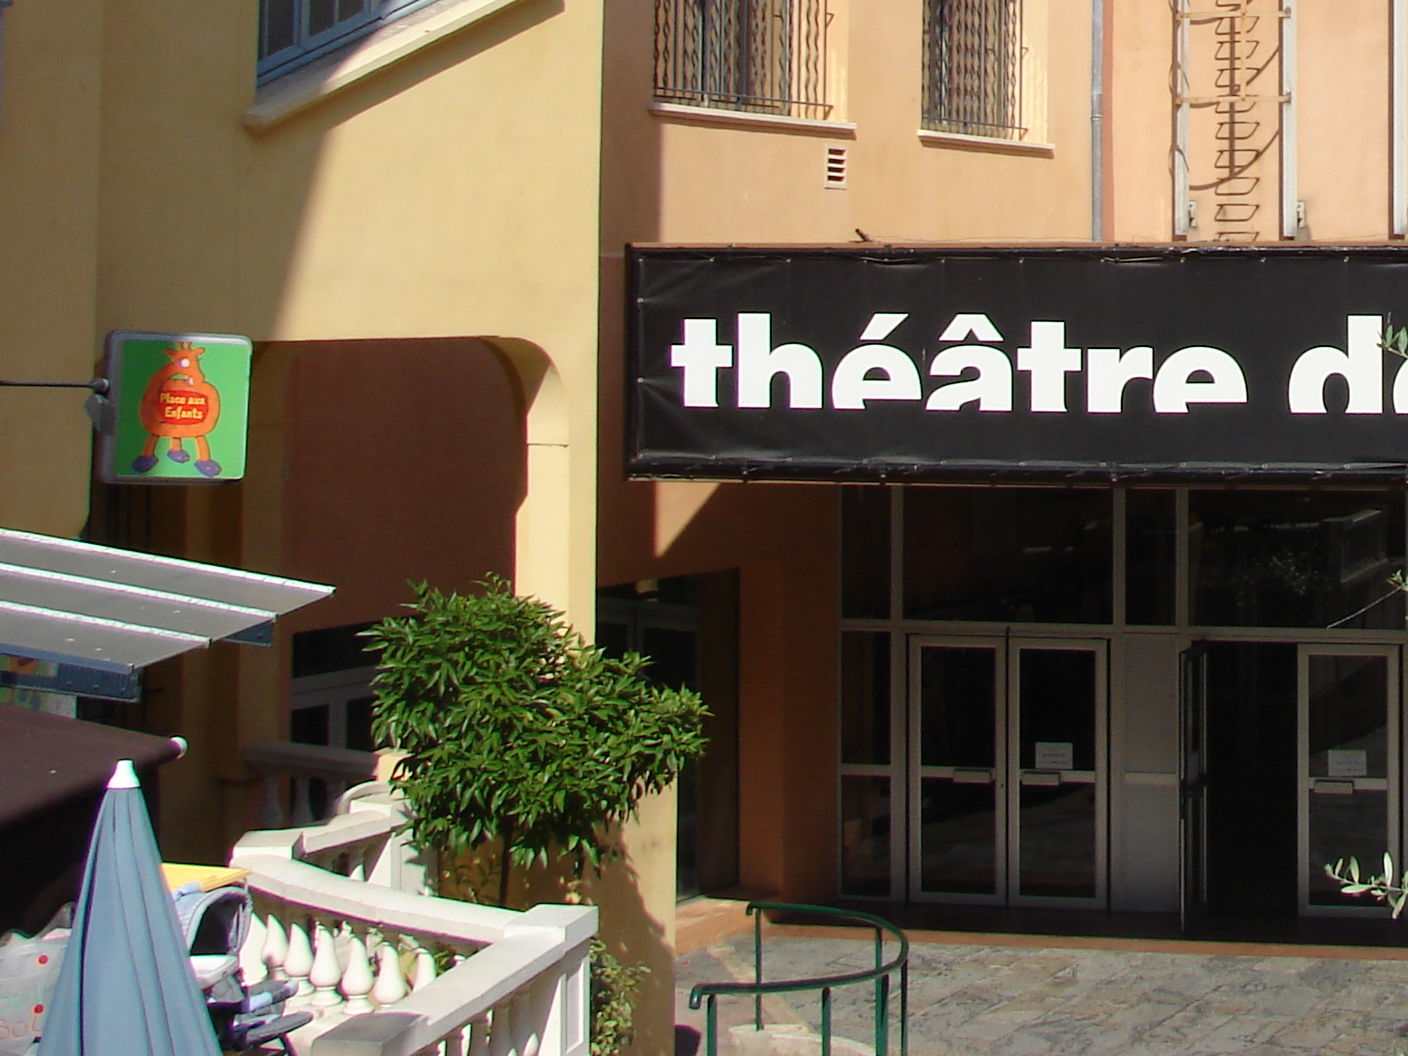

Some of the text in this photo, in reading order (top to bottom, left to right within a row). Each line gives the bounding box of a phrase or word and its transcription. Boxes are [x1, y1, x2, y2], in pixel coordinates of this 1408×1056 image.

[672, 313, 1247, 413] théâtre
[160, 393, 186, 404] Place
[165, 406, 203, 419] Enfants
